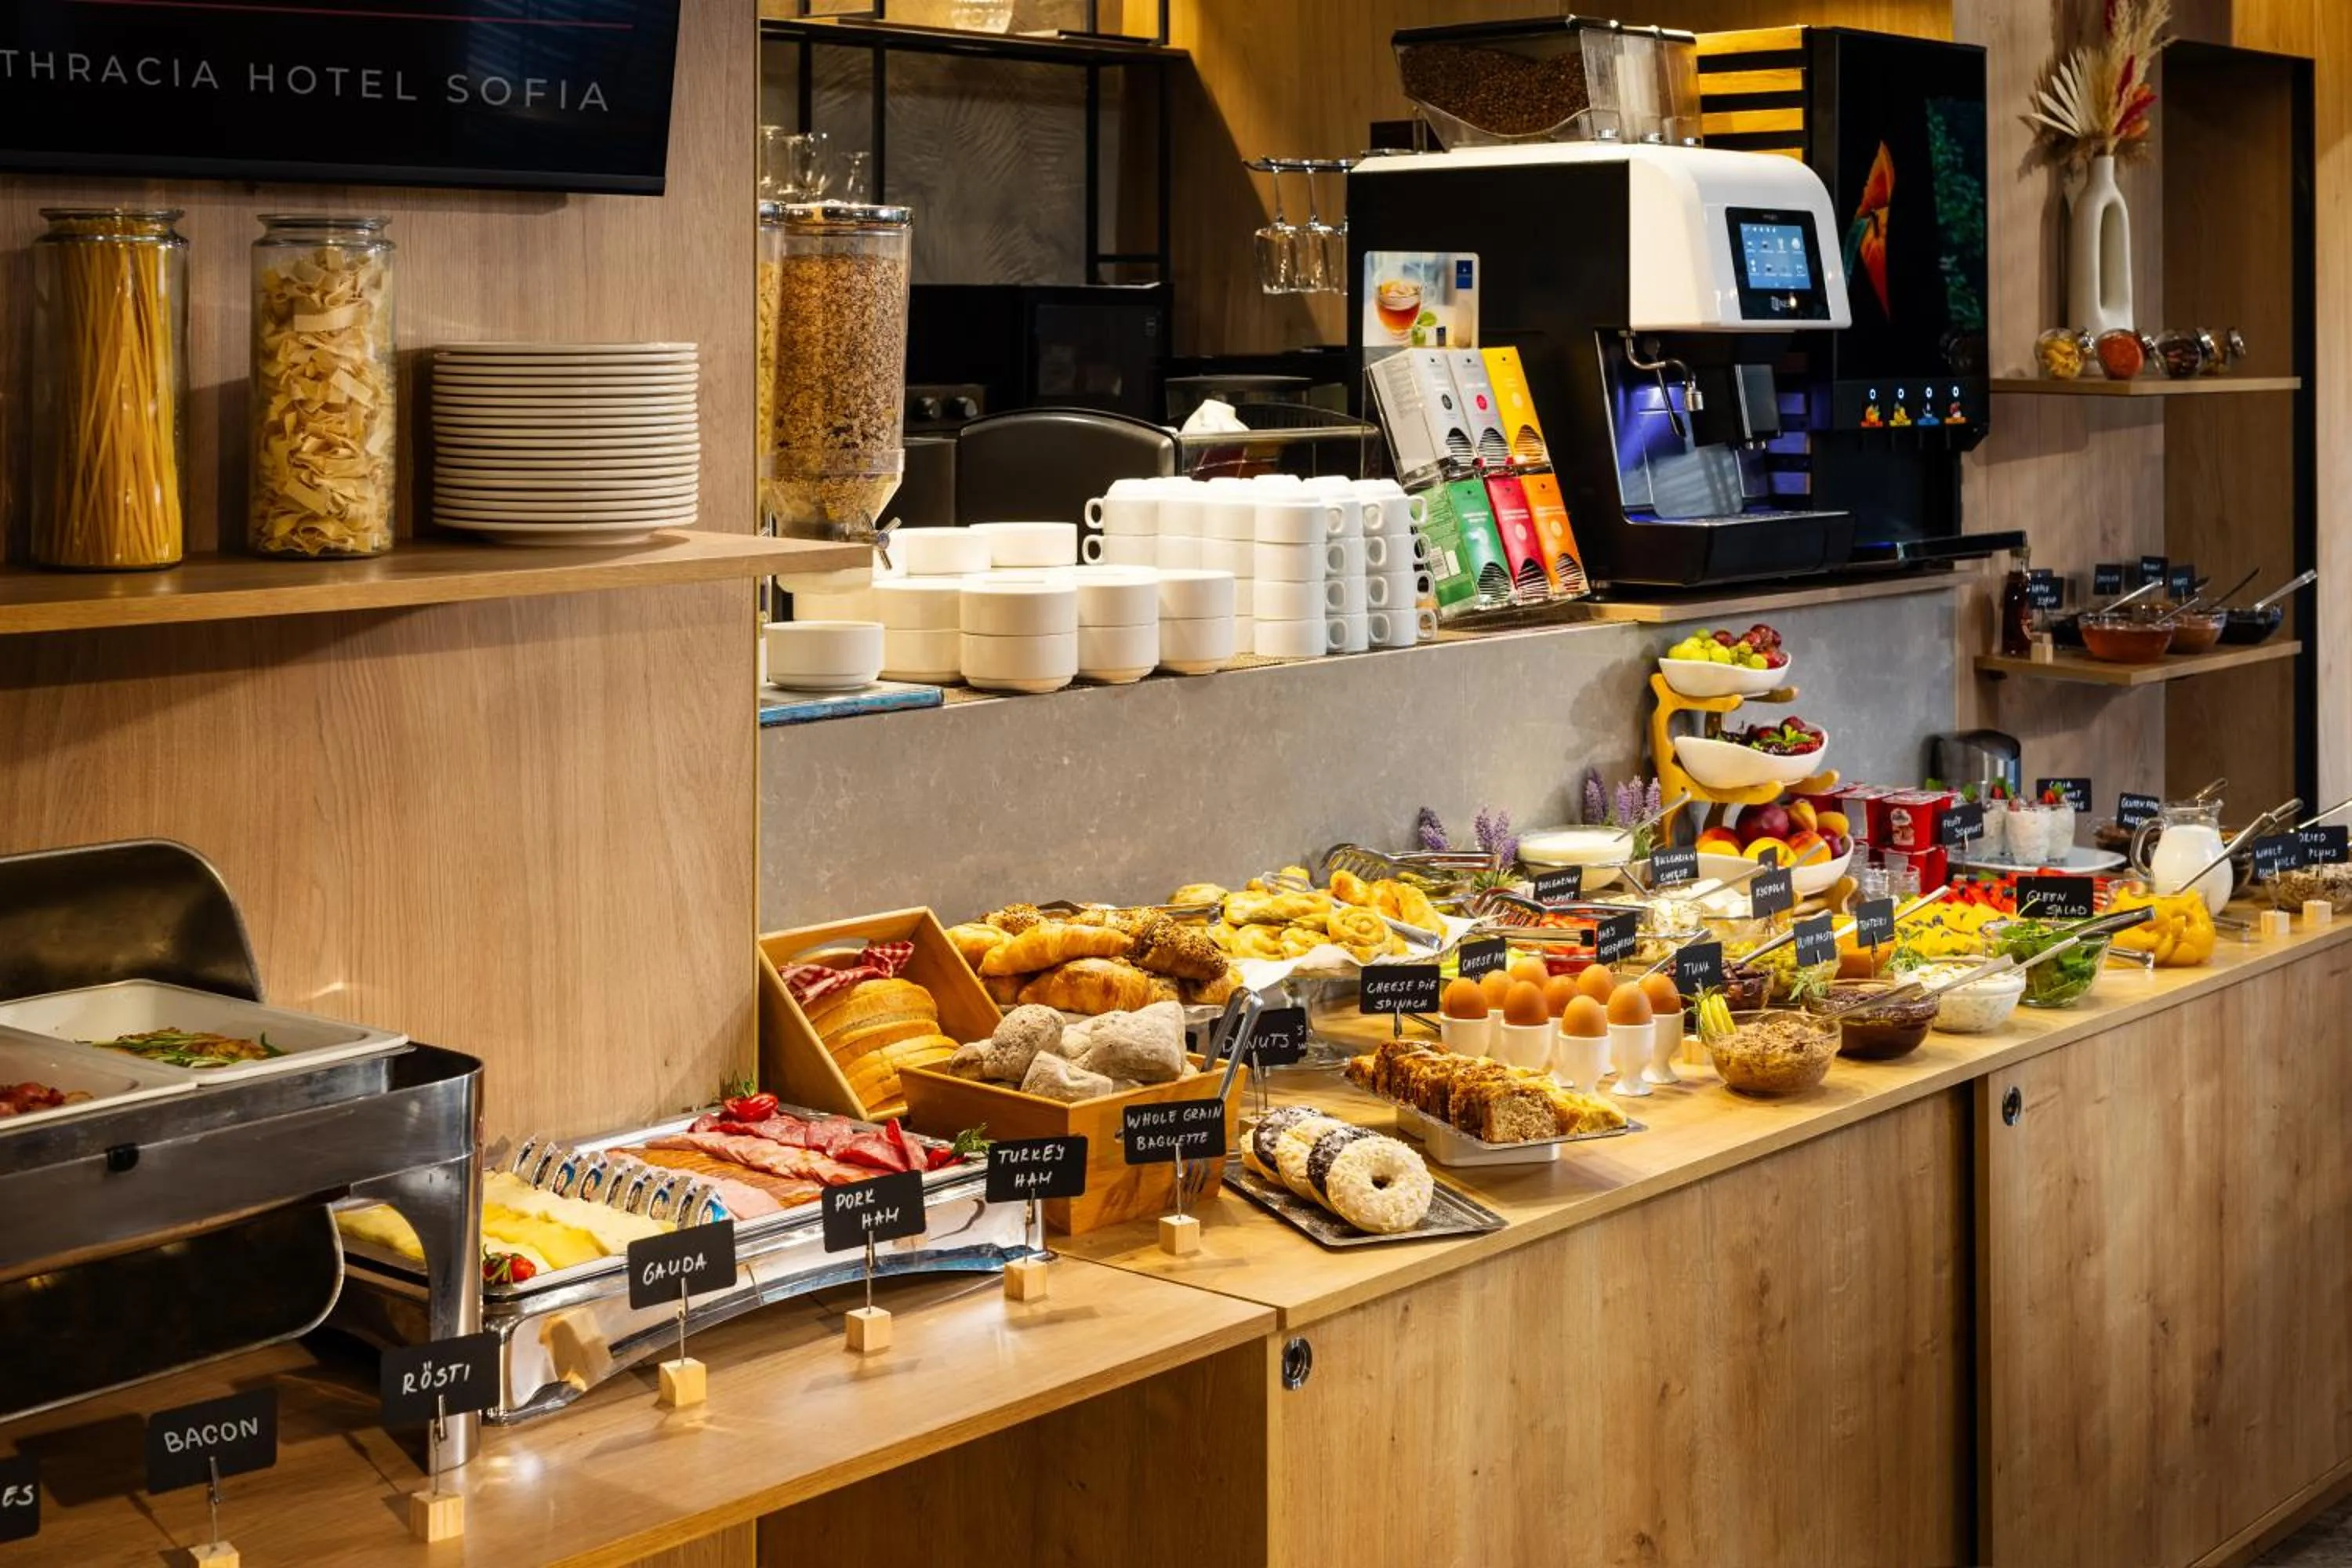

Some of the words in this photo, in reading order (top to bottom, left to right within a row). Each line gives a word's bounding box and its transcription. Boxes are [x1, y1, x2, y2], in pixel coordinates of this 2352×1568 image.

[0, 49, 220, 89] THRACIA
[249, 62, 417, 101] HOTEL
[446, 73, 610, 112] SOFIA
[2045, 904, 2087, 916] SALAD
[1683, 960, 1710, 977] TUNA
[1367, 980, 1414, 993] CHEESE
[1374, 998, 1428, 1009] SPINACH
[1221, 1033, 1290, 1053] DNUTS
[1127, 1110, 1177, 1129] WHOLE
[1182, 1104, 1222, 1122] GRAIN
[1136, 1131, 1207, 1151] BAGUETTE
[997, 1144, 1065, 1164] TURKEY
[1014, 1171, 1053, 1188] HAM
[835, 1188, 875, 1213] PORK
[862, 1207, 899, 1230] HAM
[643, 1252, 707, 1286] GAUDA
[402, 1360, 470, 1396] RÖSTI
[164, 1417, 258, 1453] BACON
